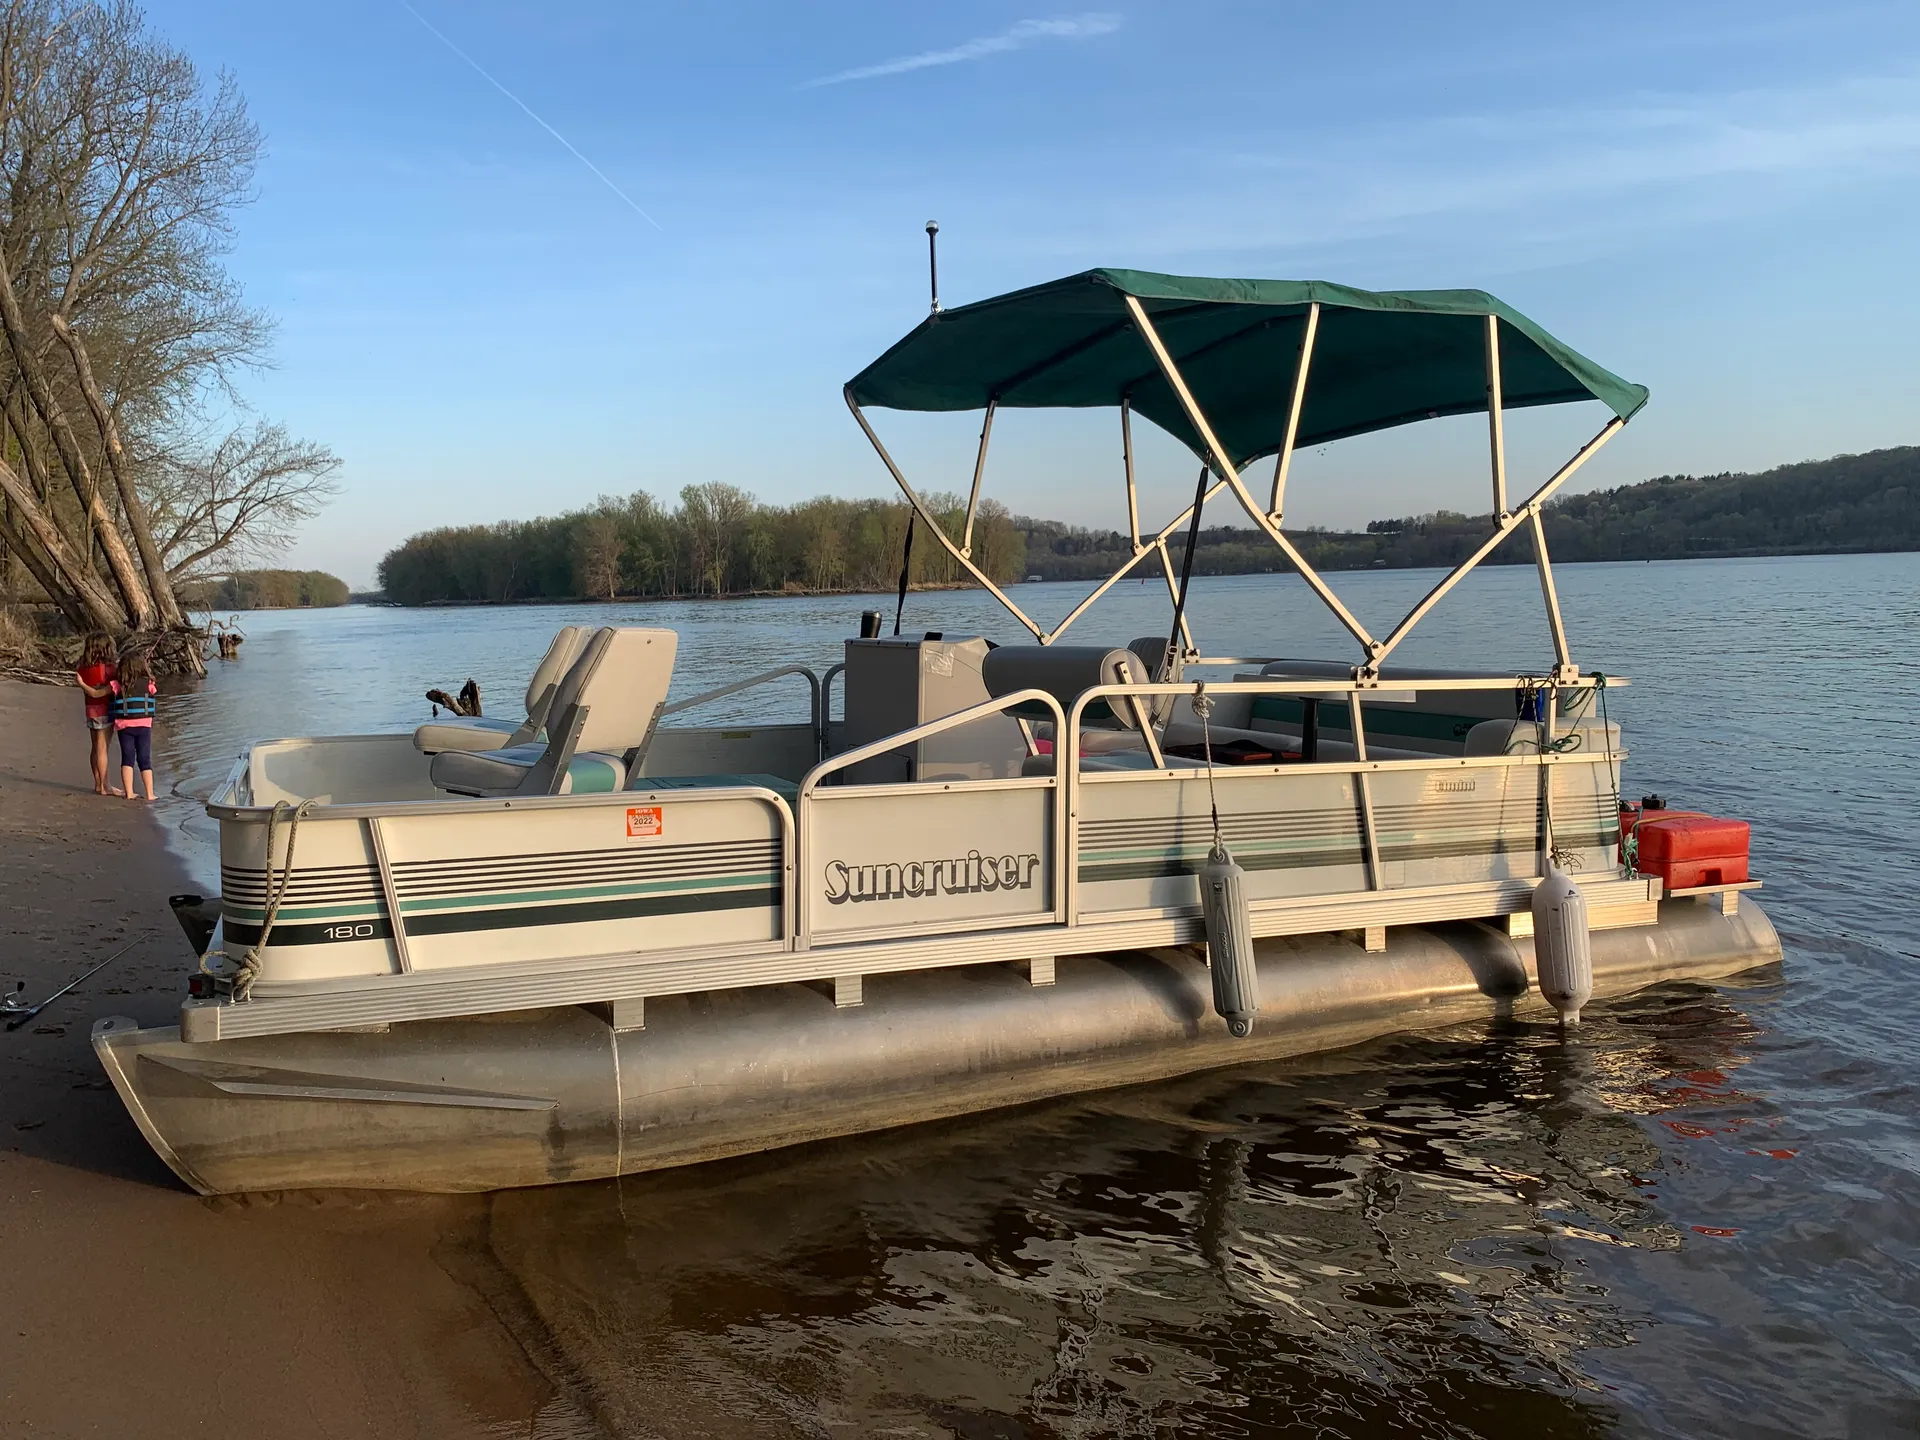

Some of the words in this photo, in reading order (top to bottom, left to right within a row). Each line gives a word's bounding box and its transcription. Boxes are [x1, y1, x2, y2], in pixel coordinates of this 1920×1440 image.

[634, 817, 653, 825] 2022
[824, 849, 1040, 905] Suncruiser
[323, 924, 374, 939] 180
